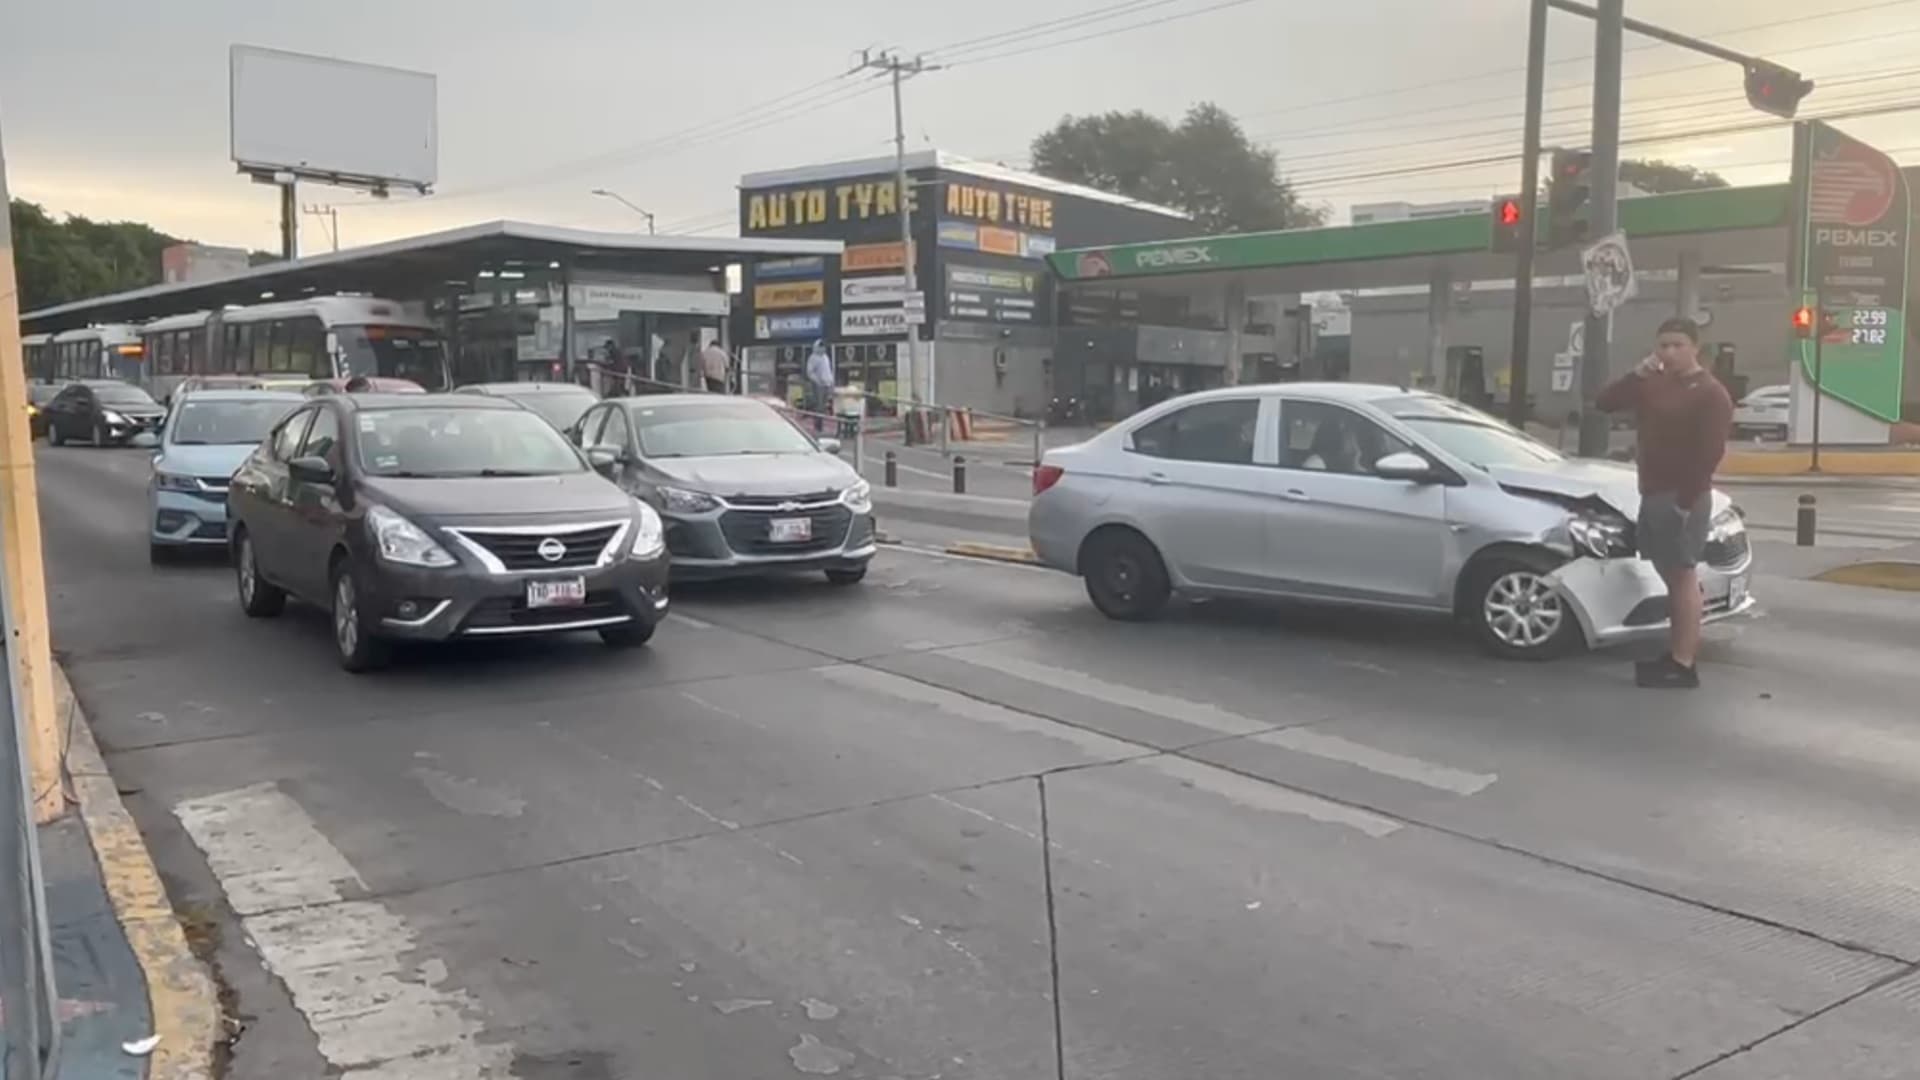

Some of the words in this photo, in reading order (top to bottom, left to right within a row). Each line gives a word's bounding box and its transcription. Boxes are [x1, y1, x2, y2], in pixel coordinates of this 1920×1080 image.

[749, 189, 826, 229] AUTO
[947, 184, 999, 222] AUTO
[1005, 193, 1053, 229] TYRE
[1816, 229, 1897, 247] PEMEX
[1136, 247, 1213, 267] PEMEX
